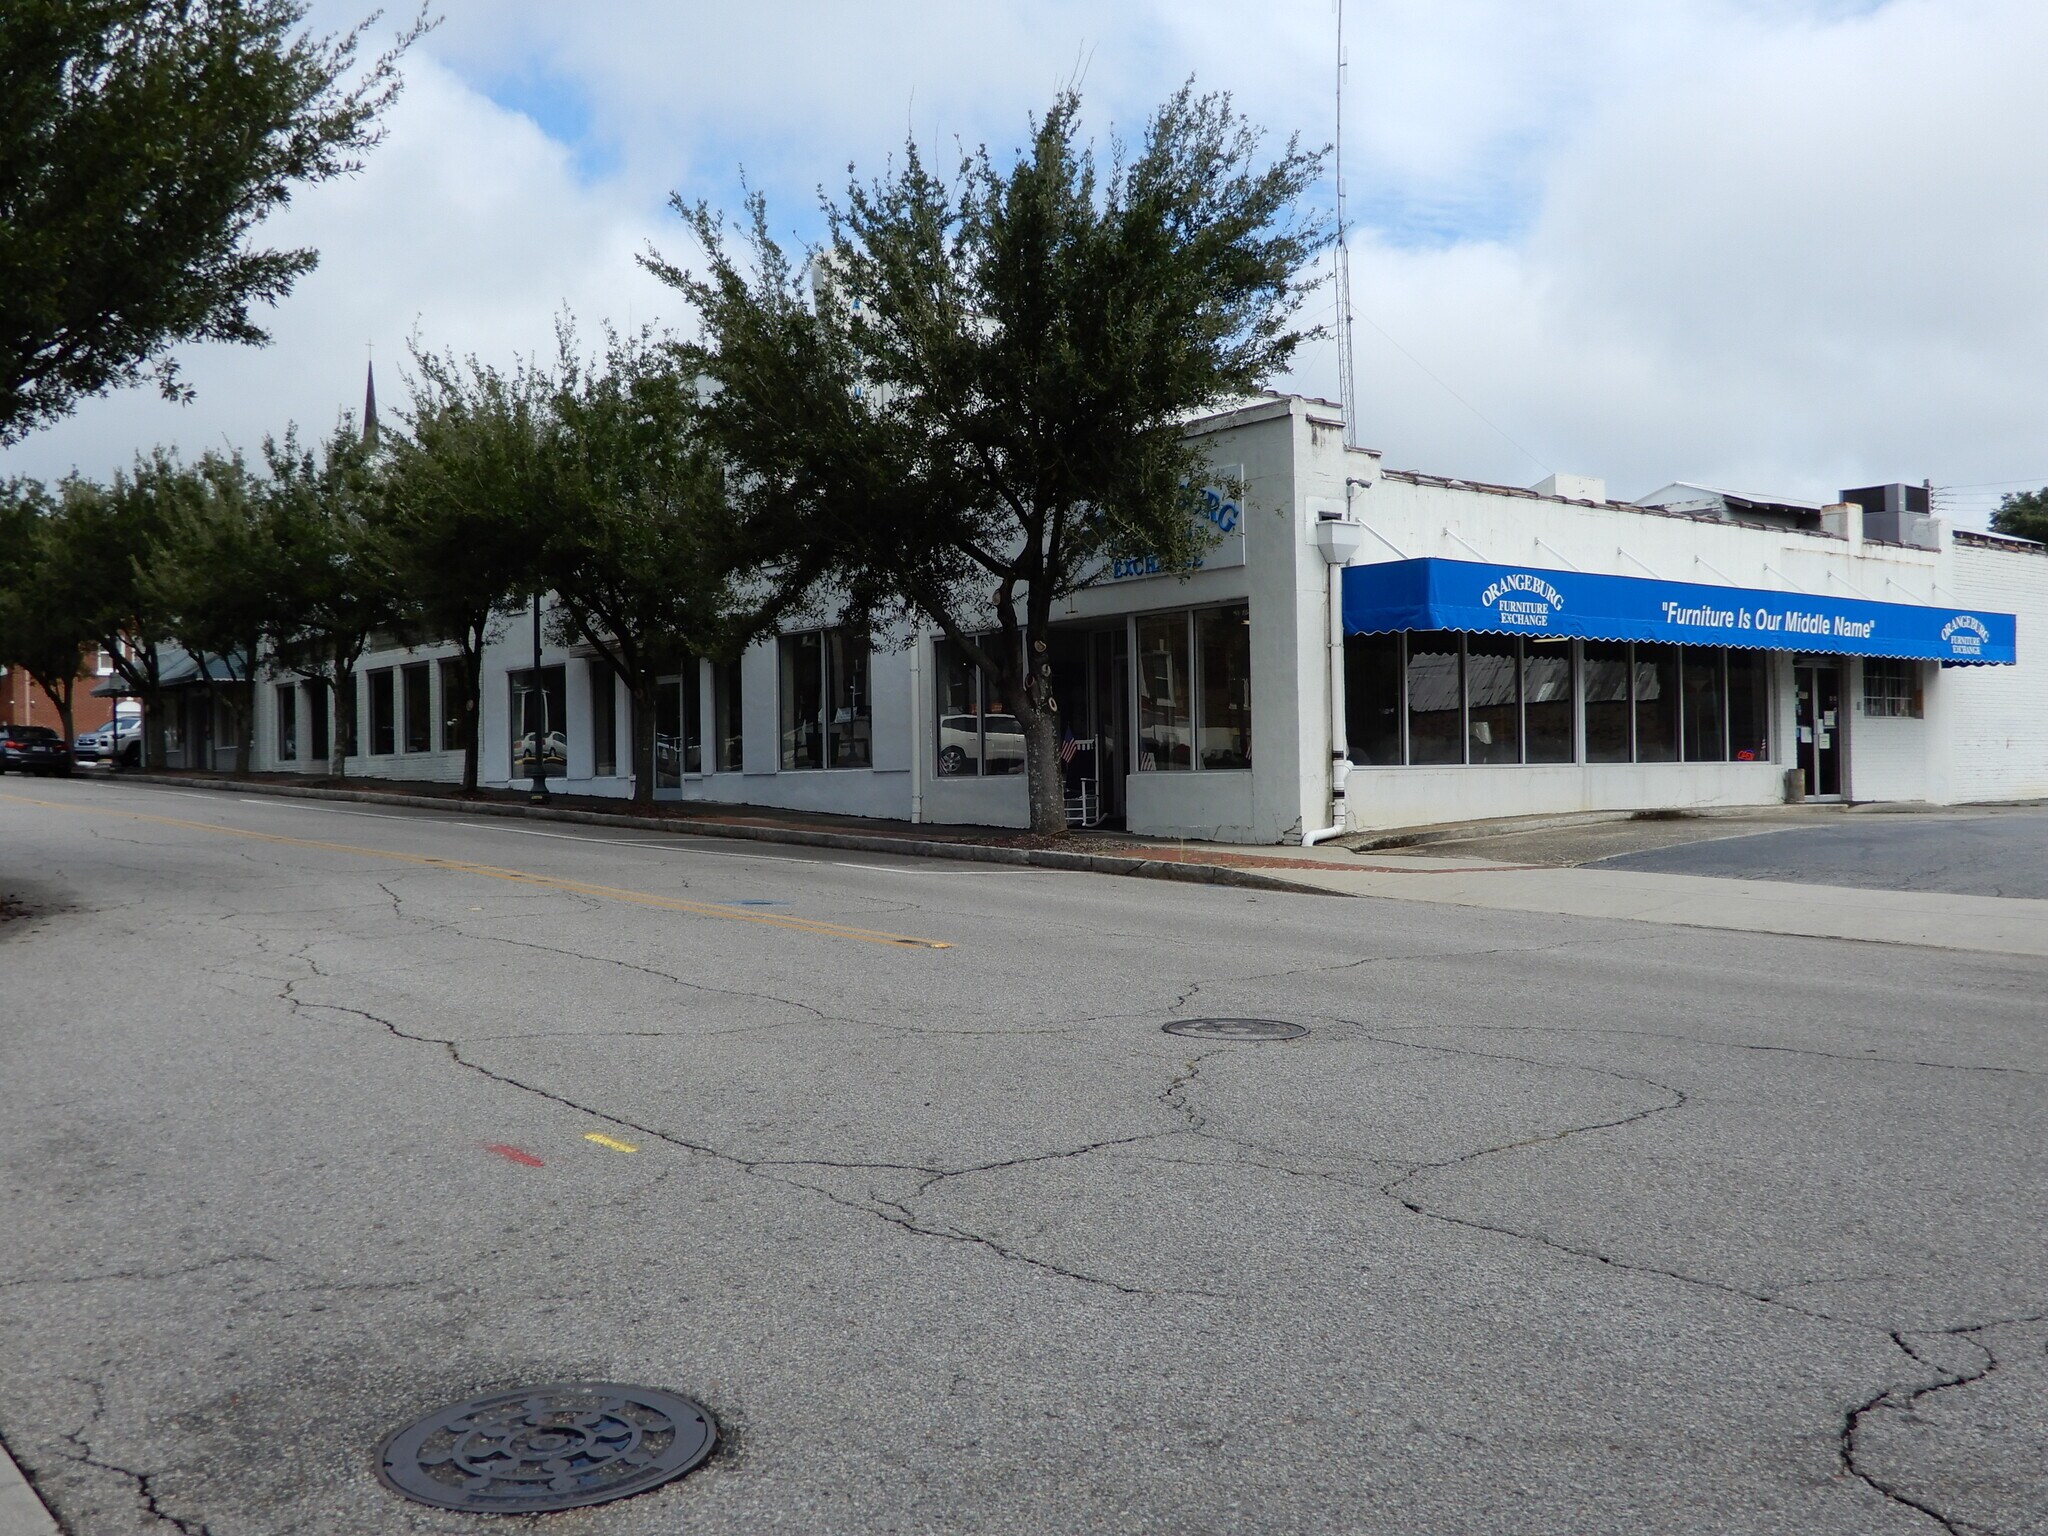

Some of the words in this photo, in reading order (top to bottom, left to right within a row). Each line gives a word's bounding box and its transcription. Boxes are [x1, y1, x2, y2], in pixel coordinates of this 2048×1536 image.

[1482, 574, 1564, 611] ORANGEBURG
[1499, 600, 1549, 614] FURNITURE
[1501, 612, 1548, 626] EXCHANGE
[1662, 602, 1734, 628] "Furniture
[1738, 607, 1751, 629] Is
[1755, 608, 1781, 631] Our
[1785, 611, 1830, 635] Middle
[1834, 616, 1875, 638] Name"
[1941, 615, 1989, 643] ORANGEBURG
